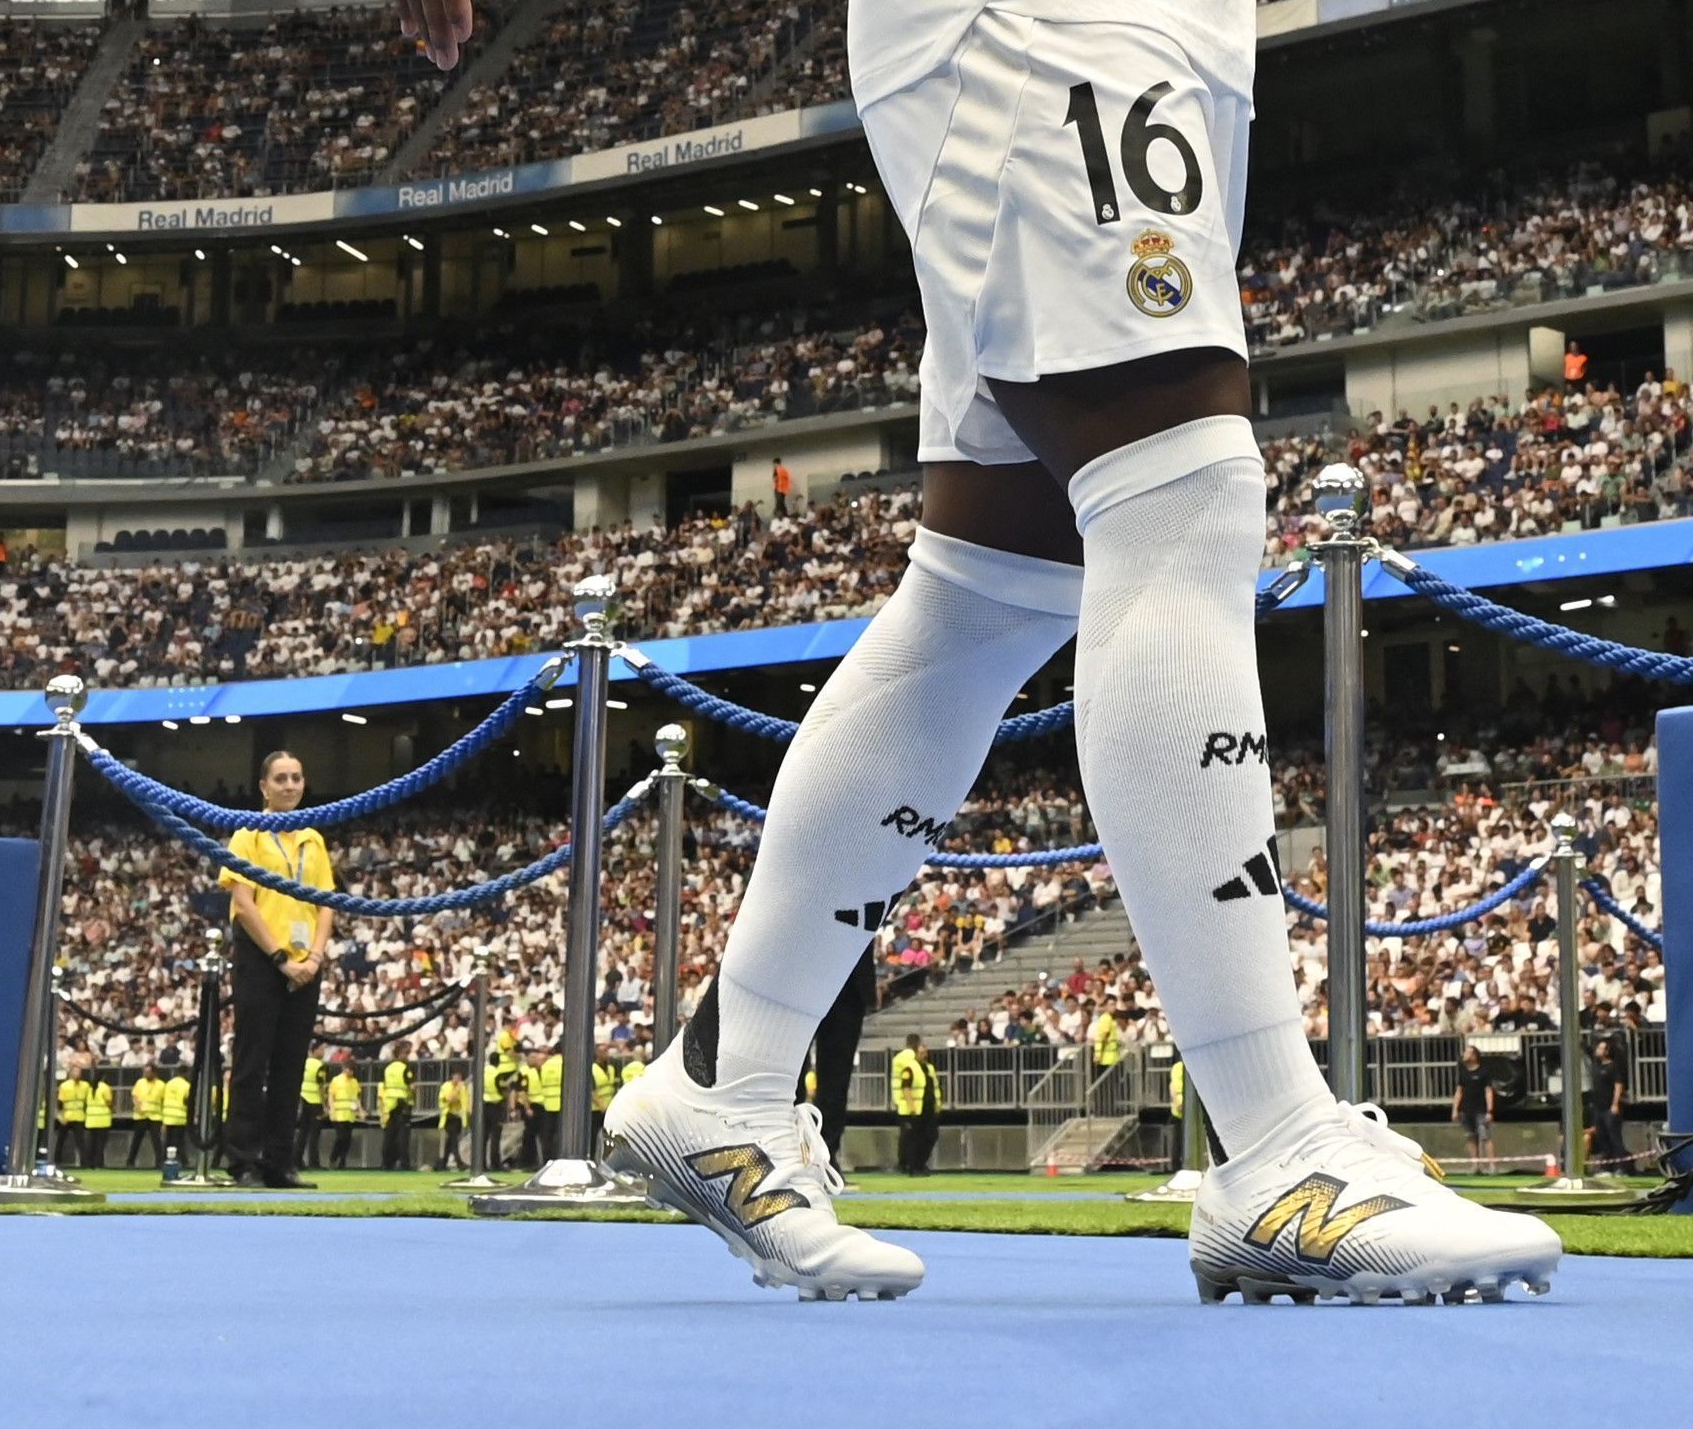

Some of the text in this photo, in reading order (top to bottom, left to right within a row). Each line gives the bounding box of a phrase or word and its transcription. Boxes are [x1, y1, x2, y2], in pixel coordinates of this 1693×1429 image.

[627, 130, 742, 172] Real Madrid
[1062, 80, 1203, 225] 16
[399, 172, 513, 208] Real Madrid
[139, 205, 273, 229] Real Madrid
[1201, 732, 1269, 768] RM
